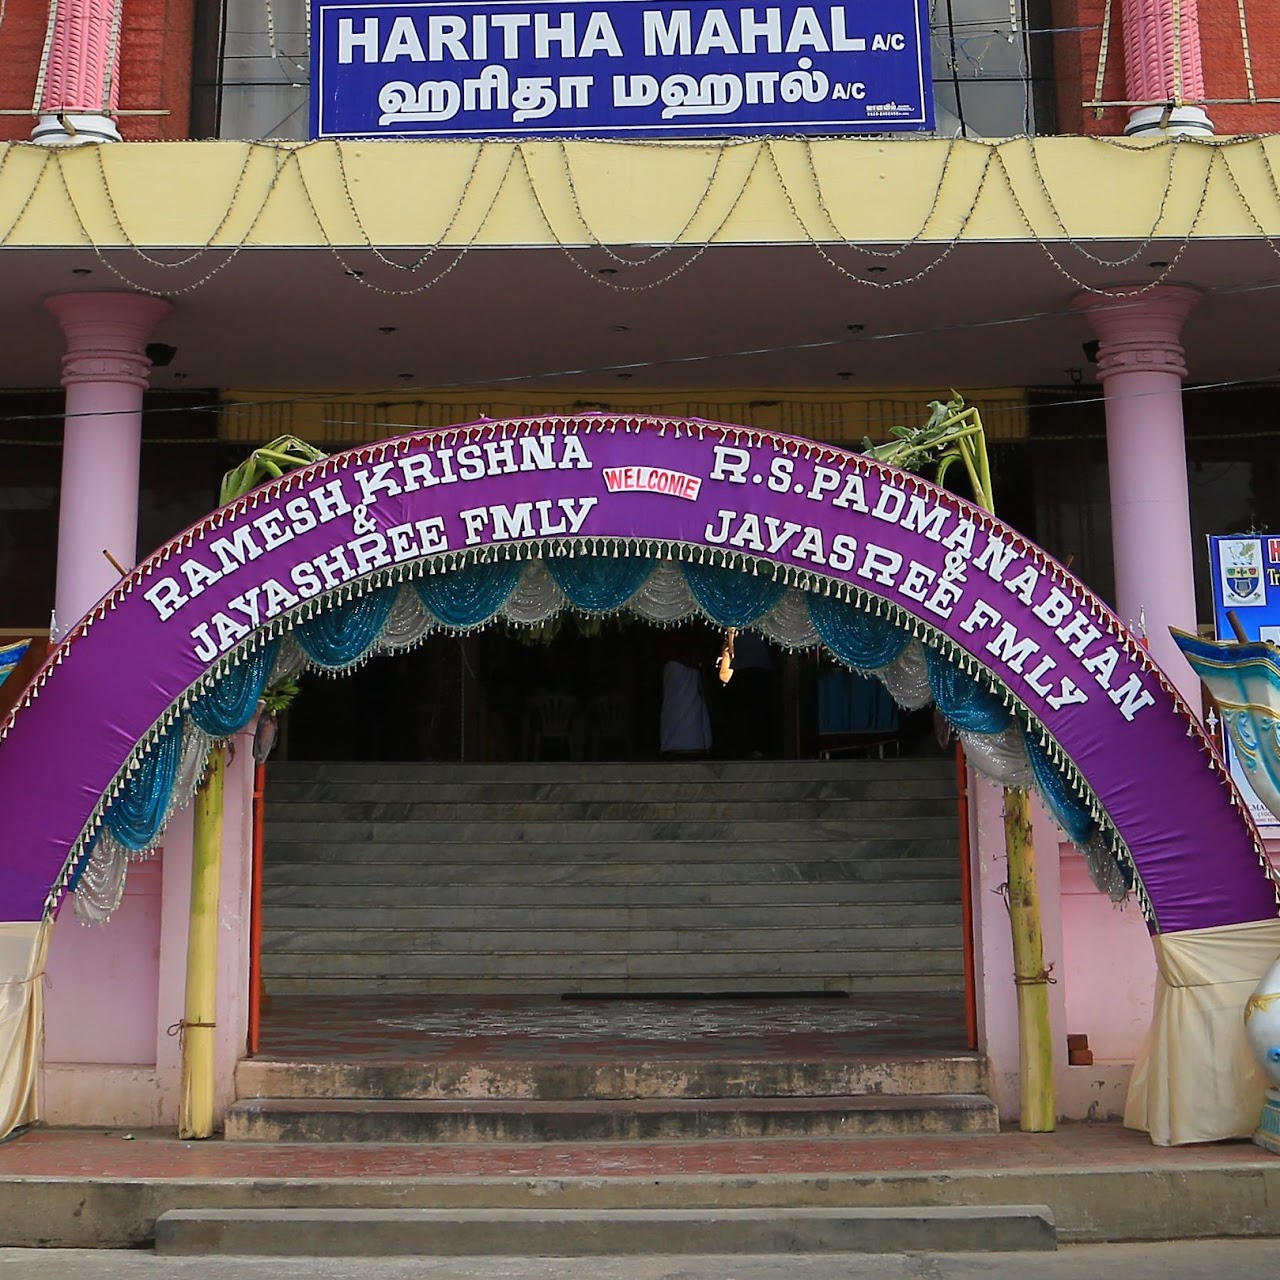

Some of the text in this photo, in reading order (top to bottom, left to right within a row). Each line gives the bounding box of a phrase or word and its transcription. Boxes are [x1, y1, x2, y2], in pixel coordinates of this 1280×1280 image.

[337, 6, 906, 64] HARITHA MAHAL A/C
[378, 58, 866, 126] ஹரிதா மஹால் A/C
[604, 466, 699, 499] WELCOME
[142, 435, 593, 623] RAMESH KRISHNA
[352, 504, 377, 534] &
[189, 496, 598, 663] JAYASHREE FMLY
[710, 444, 1156, 722] R.S.PADMANABHAN
[944, 549, 967, 583] &
[705, 510, 1088, 710] JAYASREE FMLY
